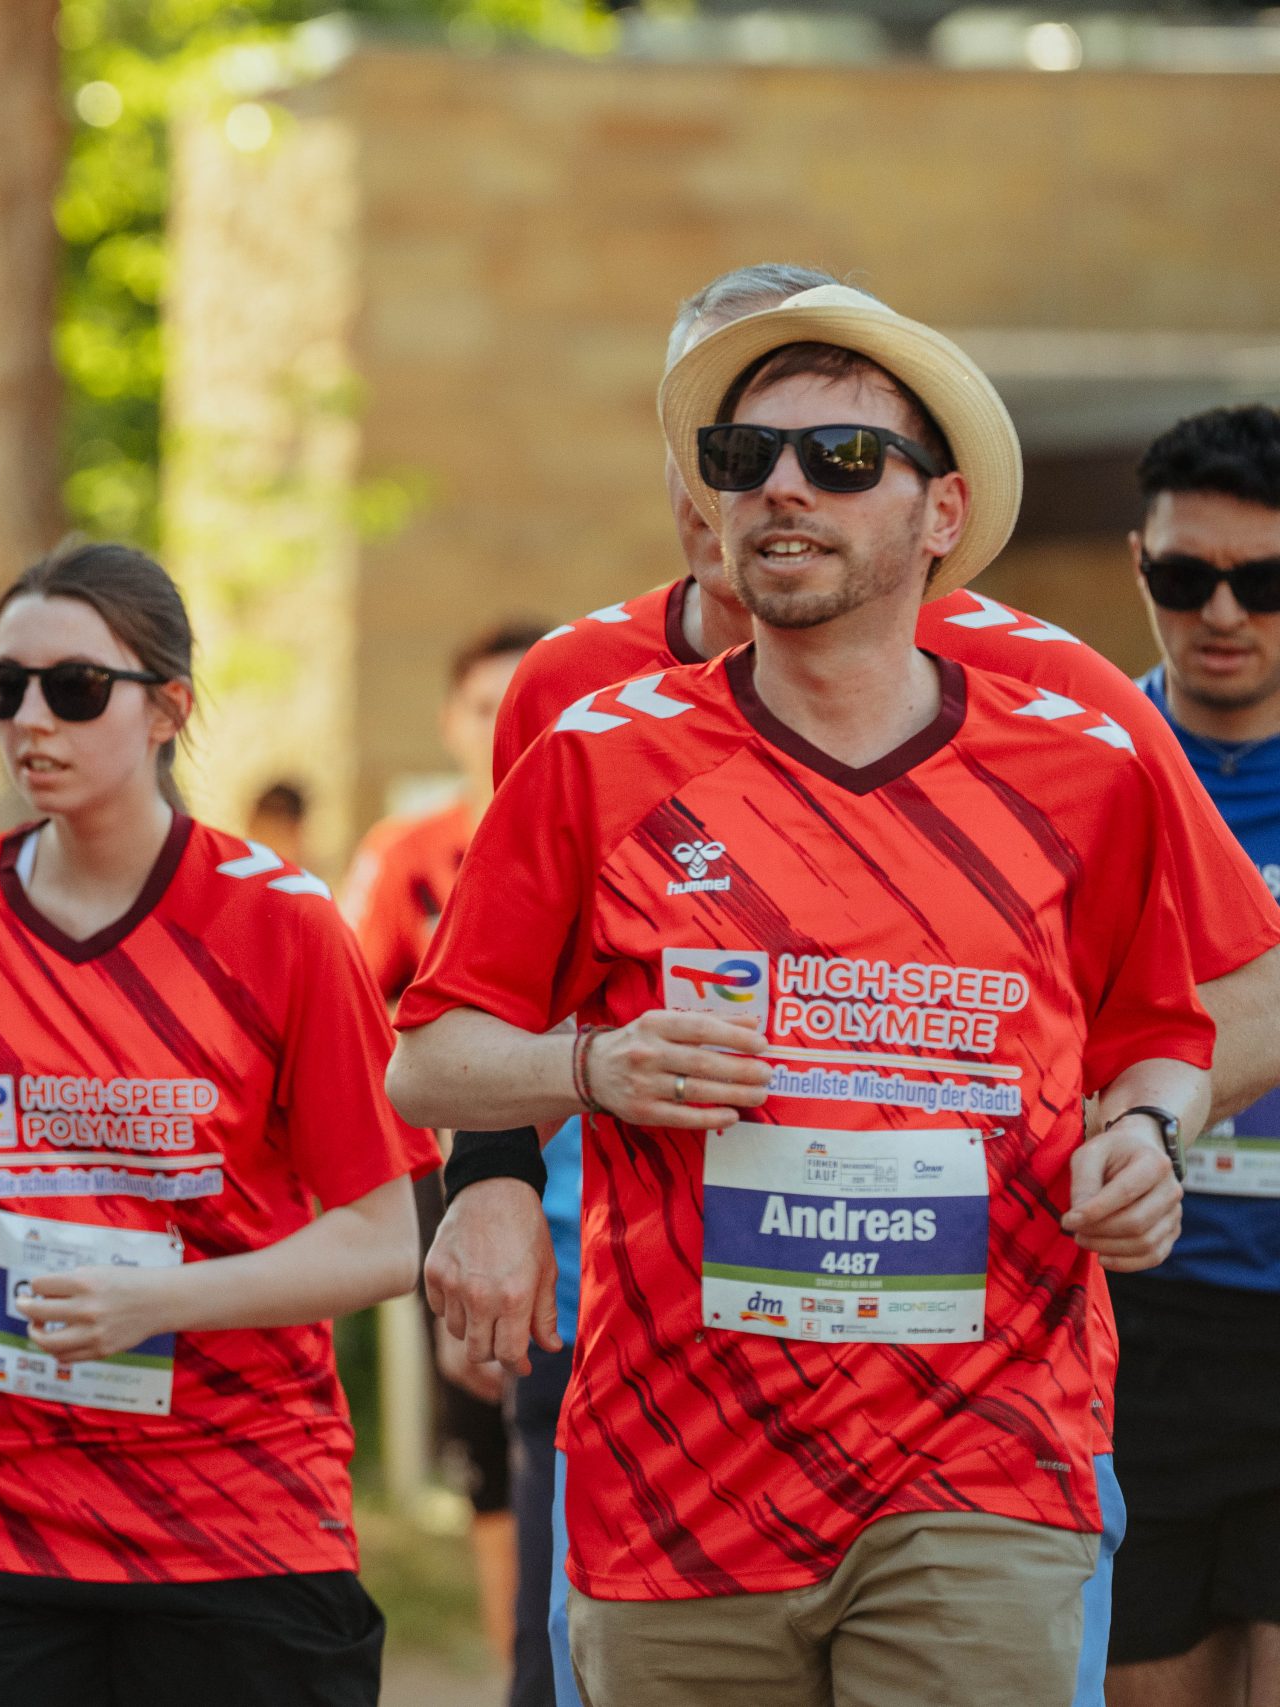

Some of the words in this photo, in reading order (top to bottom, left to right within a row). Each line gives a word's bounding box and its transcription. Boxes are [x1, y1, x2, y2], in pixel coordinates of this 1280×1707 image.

[667, 876, 730, 896] hummel
[780, 957, 1026, 1009] HIGH-SPEED
[778, 1001, 996, 1050] POLYMERE
[23, 1079, 216, 1111] HIGH-SPEED
[764, 1070, 848, 1096] chnellste
[853, 1076, 936, 1109] Mischung
[941, 1082, 966, 1106] der
[969, 1085, 1018, 1112] Stadt!
[26, 1114, 193, 1147] POLYMERE
[808, 1170, 838, 1181] LAUF
[759, 1195, 937, 1242] Andreas
[820, 1251, 880, 1274] 4487
[746, 1292, 783, 1315] dm
